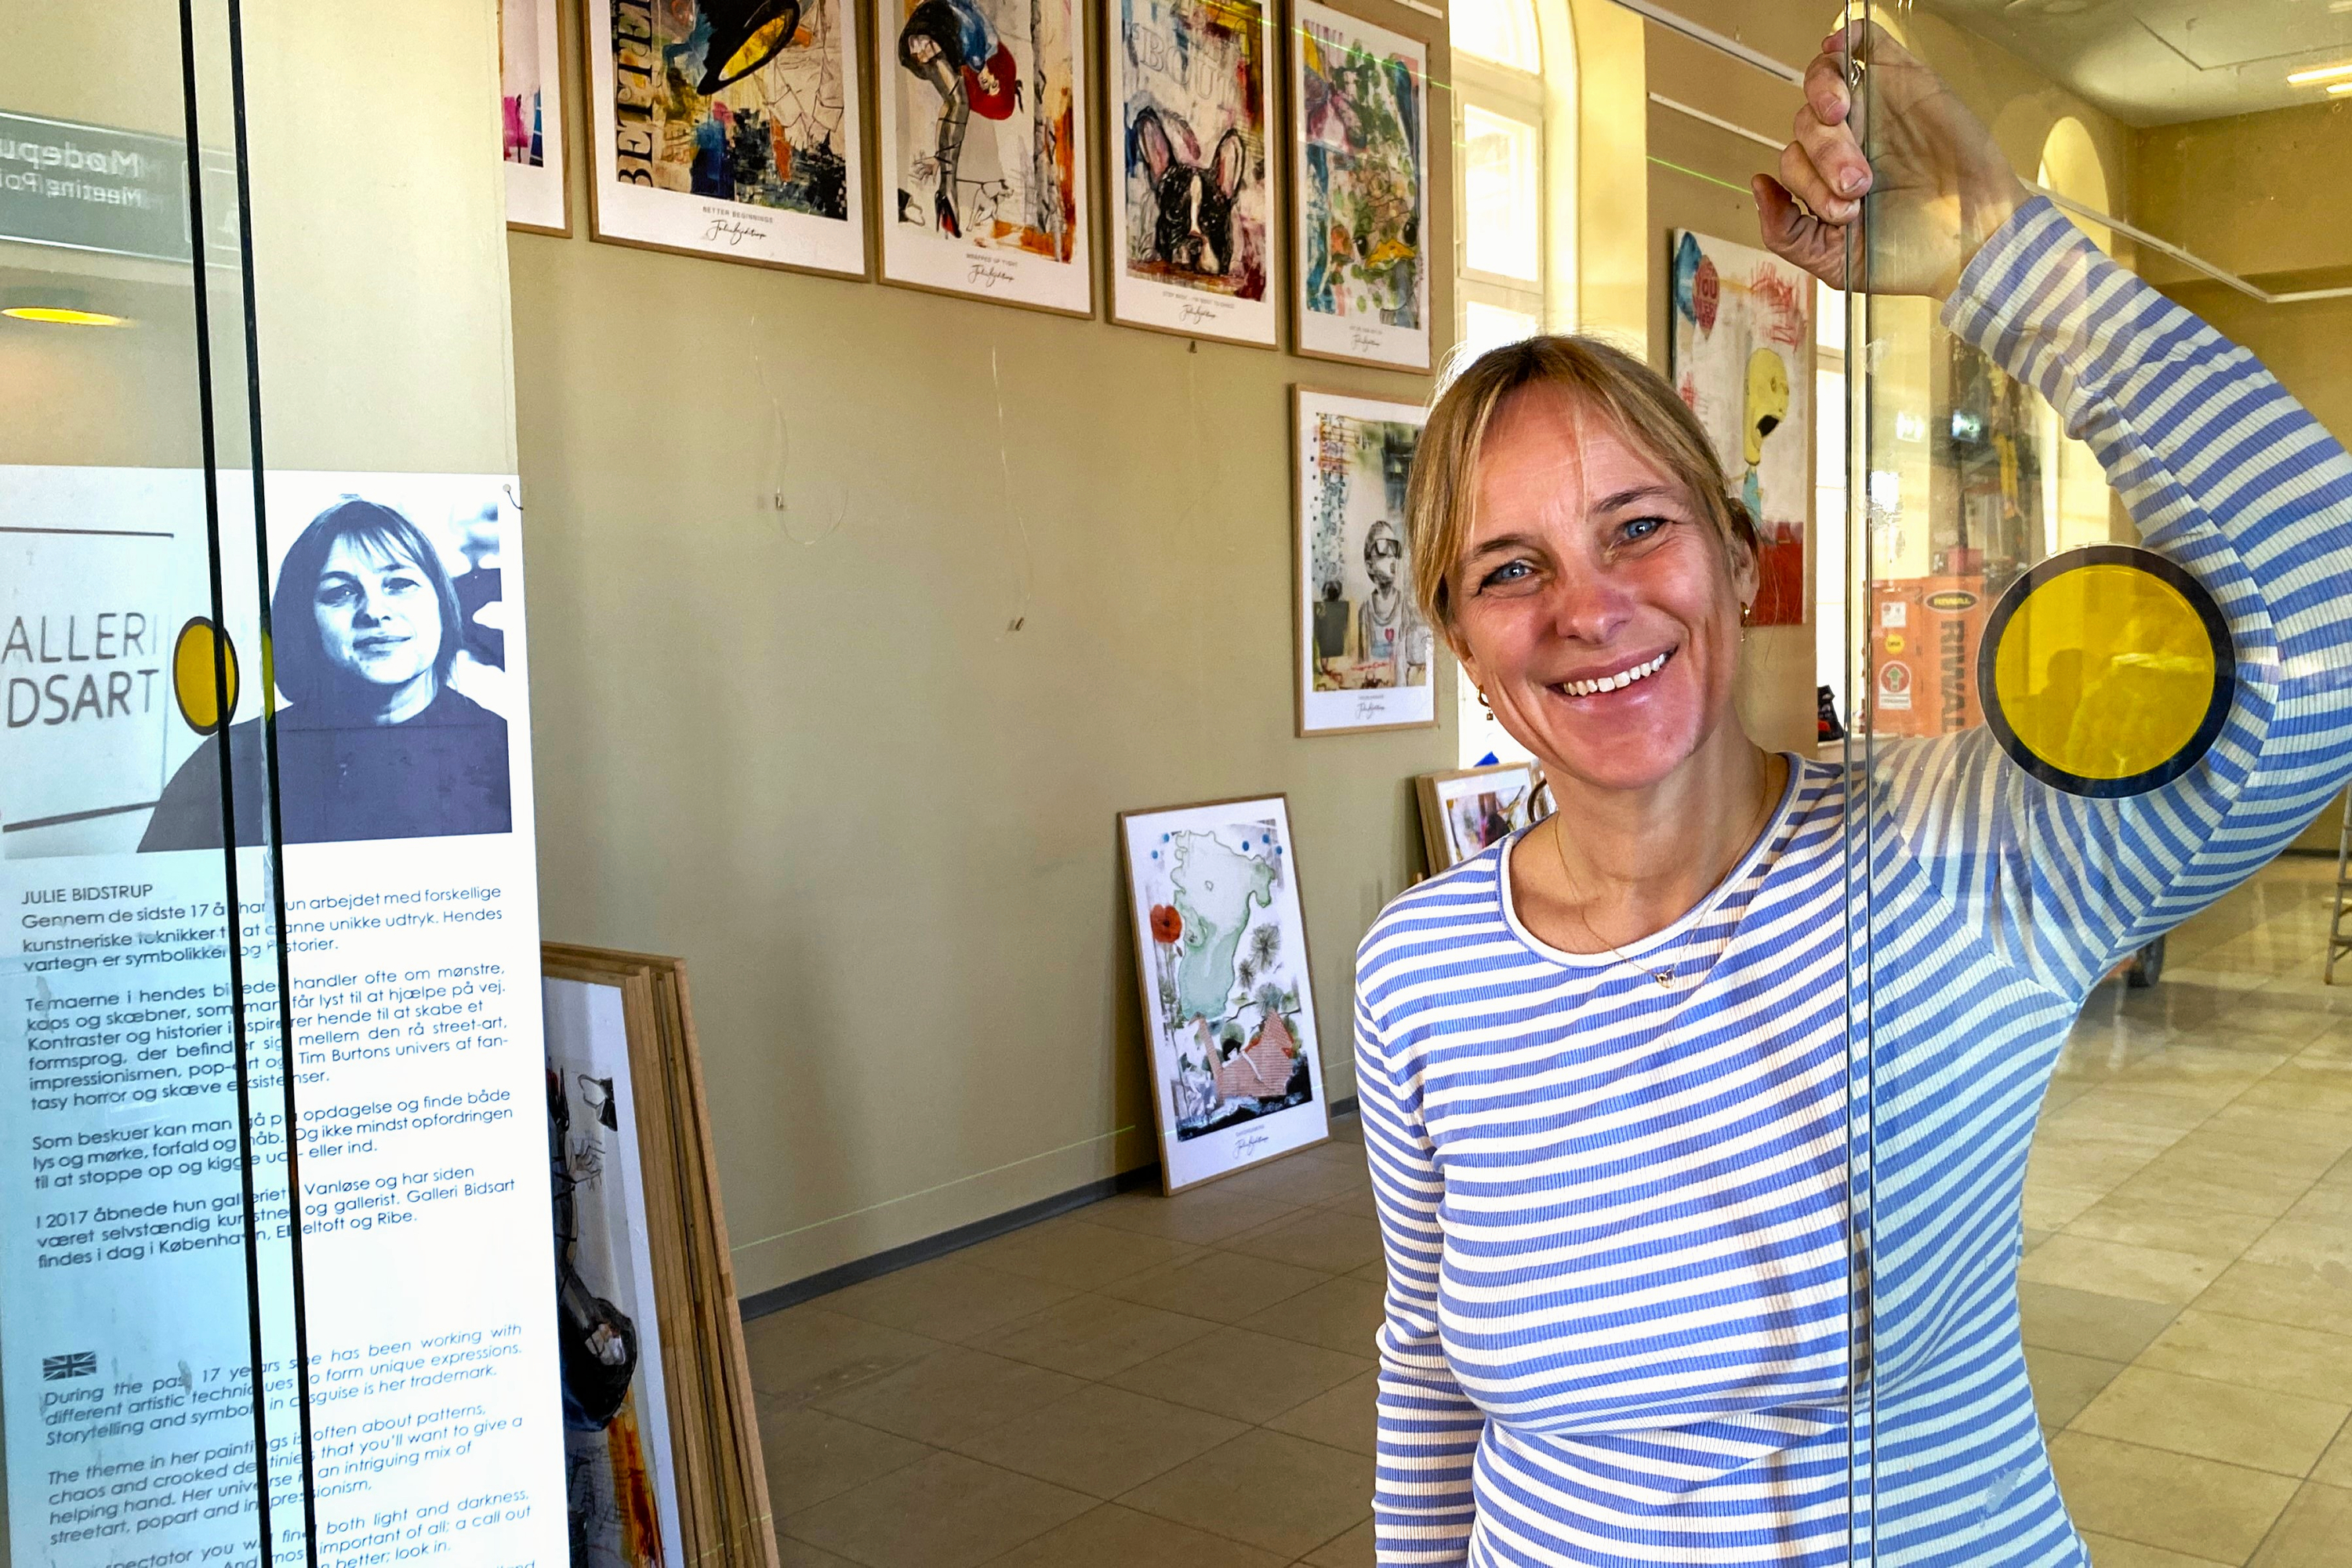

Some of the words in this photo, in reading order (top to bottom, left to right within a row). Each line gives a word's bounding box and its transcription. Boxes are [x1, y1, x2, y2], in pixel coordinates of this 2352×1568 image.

[21, 889, 67, 905] JULIE
[72, 884, 153, 901] BIDSTRUP
[22, 913, 104, 928] Gennem
[108, 909, 132, 923] de
[137, 906, 185, 921] sidste
[191, 904, 209, 917] 17
[310, 893, 379, 909] arbejdet
[384, 891, 420, 904] med
[425, 887, 501, 902] forskellige
[24, 934, 132, 953] kunstneriske
[243, 924, 260, 937] at
[330, 916, 380, 931] unikke
[386, 913, 438, 927] udtryk.
[444, 909, 502, 922] Hendes
[24, 957, 97, 971] vartegn
[103, 956, 121, 967] er
[25, 993, 119, 1011] Temaerne
[140, 986, 205, 1003] hendes
[294, 975, 358, 989] handler
[365, 971, 397, 984] ofte
[405, 971, 430, 981] om
[438, 964, 504, 978] mønstre,
[25, 1014, 69, 1034] kaos
[75, 1016, 100, 1029] og
[107, 1009, 191, 1025] skæbner,
[292, 994, 314, 1008] får
[320, 993, 343, 1008] lyst
[350, 991, 361, 1004] til
[368, 990, 383, 1002] at
[390, 986, 446, 1003] hjælpe
[452, 982, 473, 998] på
[479, 980, 505, 995] vej.
[28, 1033, 121, 1051] Kontraster
[126, 1032, 150, 1044] og
[157, 1023, 223, 1040] historier
[318, 1010, 371, 1025] hende
[377, 1007, 388, 1020] til
[394, 1007, 410, 1018] at
[416, 1003, 462, 1017] skabe
[468, 1000, 482, 1012] et
[29, 1054, 127, 1070] formsprog,
[137, 1047, 167, 1061] der
[299, 1031, 359, 1045] mellem
[368, 1027, 400, 1040] den
[408, 1022, 424, 1036] rå
[434, 1017, 506, 1033] street-art,
[30, 1068, 182, 1091] impressionismen,
[299, 1051, 325, 1064] Tim
[332, 1047, 390, 1062] Burtons
[396, 1042, 450, 1055] univers
[456, 1037, 471, 1050] af
[477, 1036, 507, 1047] fan-
[31, 1098, 68, 1111] tasy
[74, 1091, 127, 1106] horror
[132, 1089, 157, 1102] og
[162, 1083, 221, 1098] skæve
[33, 1136, 72, 1150] Som
[78, 1128, 149, 1145] beskuer
[154, 1124, 186, 1137] kan
[192, 1120, 232, 1134] man
[303, 1102, 392, 1122] opdagelse
[397, 1101, 418, 1112] og
[424, 1094, 462, 1108] finde
[468, 1089, 510, 1104] både
[34, 1156, 55, 1172] lys
[59, 1156, 83, 1169] og
[88, 1148, 148, 1163] mørke,
[153, 1139, 209, 1156] forfald
[213, 1139, 236, 1152] og
[322, 1124, 352, 1138] ikke
[358, 1117, 408, 1134] mindst
[412, 1109, 513, 1130] opfordringen
[34, 1175, 48, 1189] til
[54, 1174, 73, 1187] at
[79, 1169, 142, 1185] stoppe
[148, 1165, 172, 1179] op
[309, 1145, 343, 1158] eller
[348, 1139, 377, 1153] ind.
[37, 1229, 94, 1247] været
[102, 1217, 209, 1241] selvstændig
[335, 1193, 399, 1214] gallerist.
[407, 1185, 457, 1203] Galleri
[465, 1179, 514, 1196] Bidsart
[46, 1210, 88, 1228] 2017
[94, 1203, 167, 1222] åbnede
[173, 1200, 206, 1213] hun
[304, 1180, 369, 1195] Vanløse
[403, 1173, 428, 1185] har
[434, 1167, 474, 1181] siden
[38, 1253, 92, 1268] findes
[107, 1247, 144, 1260] dag
[378, 1212, 416, 1225] Ribe.
[45, 1388, 104, 1406] During
[114, 1382, 143, 1395] the
[332, 1349, 359, 1362] has
[368, 1342, 411, 1356] been
[421, 1332, 481, 1348] working
[491, 1324, 521, 1338] with
[45, 1403, 122, 1425] different
[129, 1395, 184, 1413] artistic
[327, 1368, 363, 1381] form
[371, 1359, 424, 1375] unique
[46, 1421, 144, 1446] Storytelling
[150, 1413, 186, 1429] and
[379, 1380, 405, 1392] her
[48, 1471, 79, 1485] The
[87, 1461, 144, 1479] theme
[171, 1451, 200, 1465] her
[314, 1426, 356, 1440] often
[362, 1414, 412, 1432] about
[49, 1486, 105, 1505] chaos
[111, 1477, 147, 1494] and
[154, 1464, 228, 1487] crooked
[322, 1442, 354, 1458] that
[360, 1434, 402, 1455] you'll
[408, 1427, 447, 1443] want
[474, 1421, 506, 1436] give
[50, 1504, 118, 1525] helping
[183, 1488, 212, 1503] Her
[345, 1454, 419, 1473] intriguing
[425, 1446, 450, 1460] mix
[136, 1508, 198, 1534] popart
[204, 1501, 239, 1519] and
[201, 1544, 234, 1562] you
[327, 1517, 365, 1534] both
[375, 1508, 407, 1527] light
[416, 1501, 448, 1518] and
[320, 1529, 400, 1554] important
[473, 1511, 499, 1526] call
[506, 1505, 530, 1520] out
[396, 1543, 428, 1559] look
